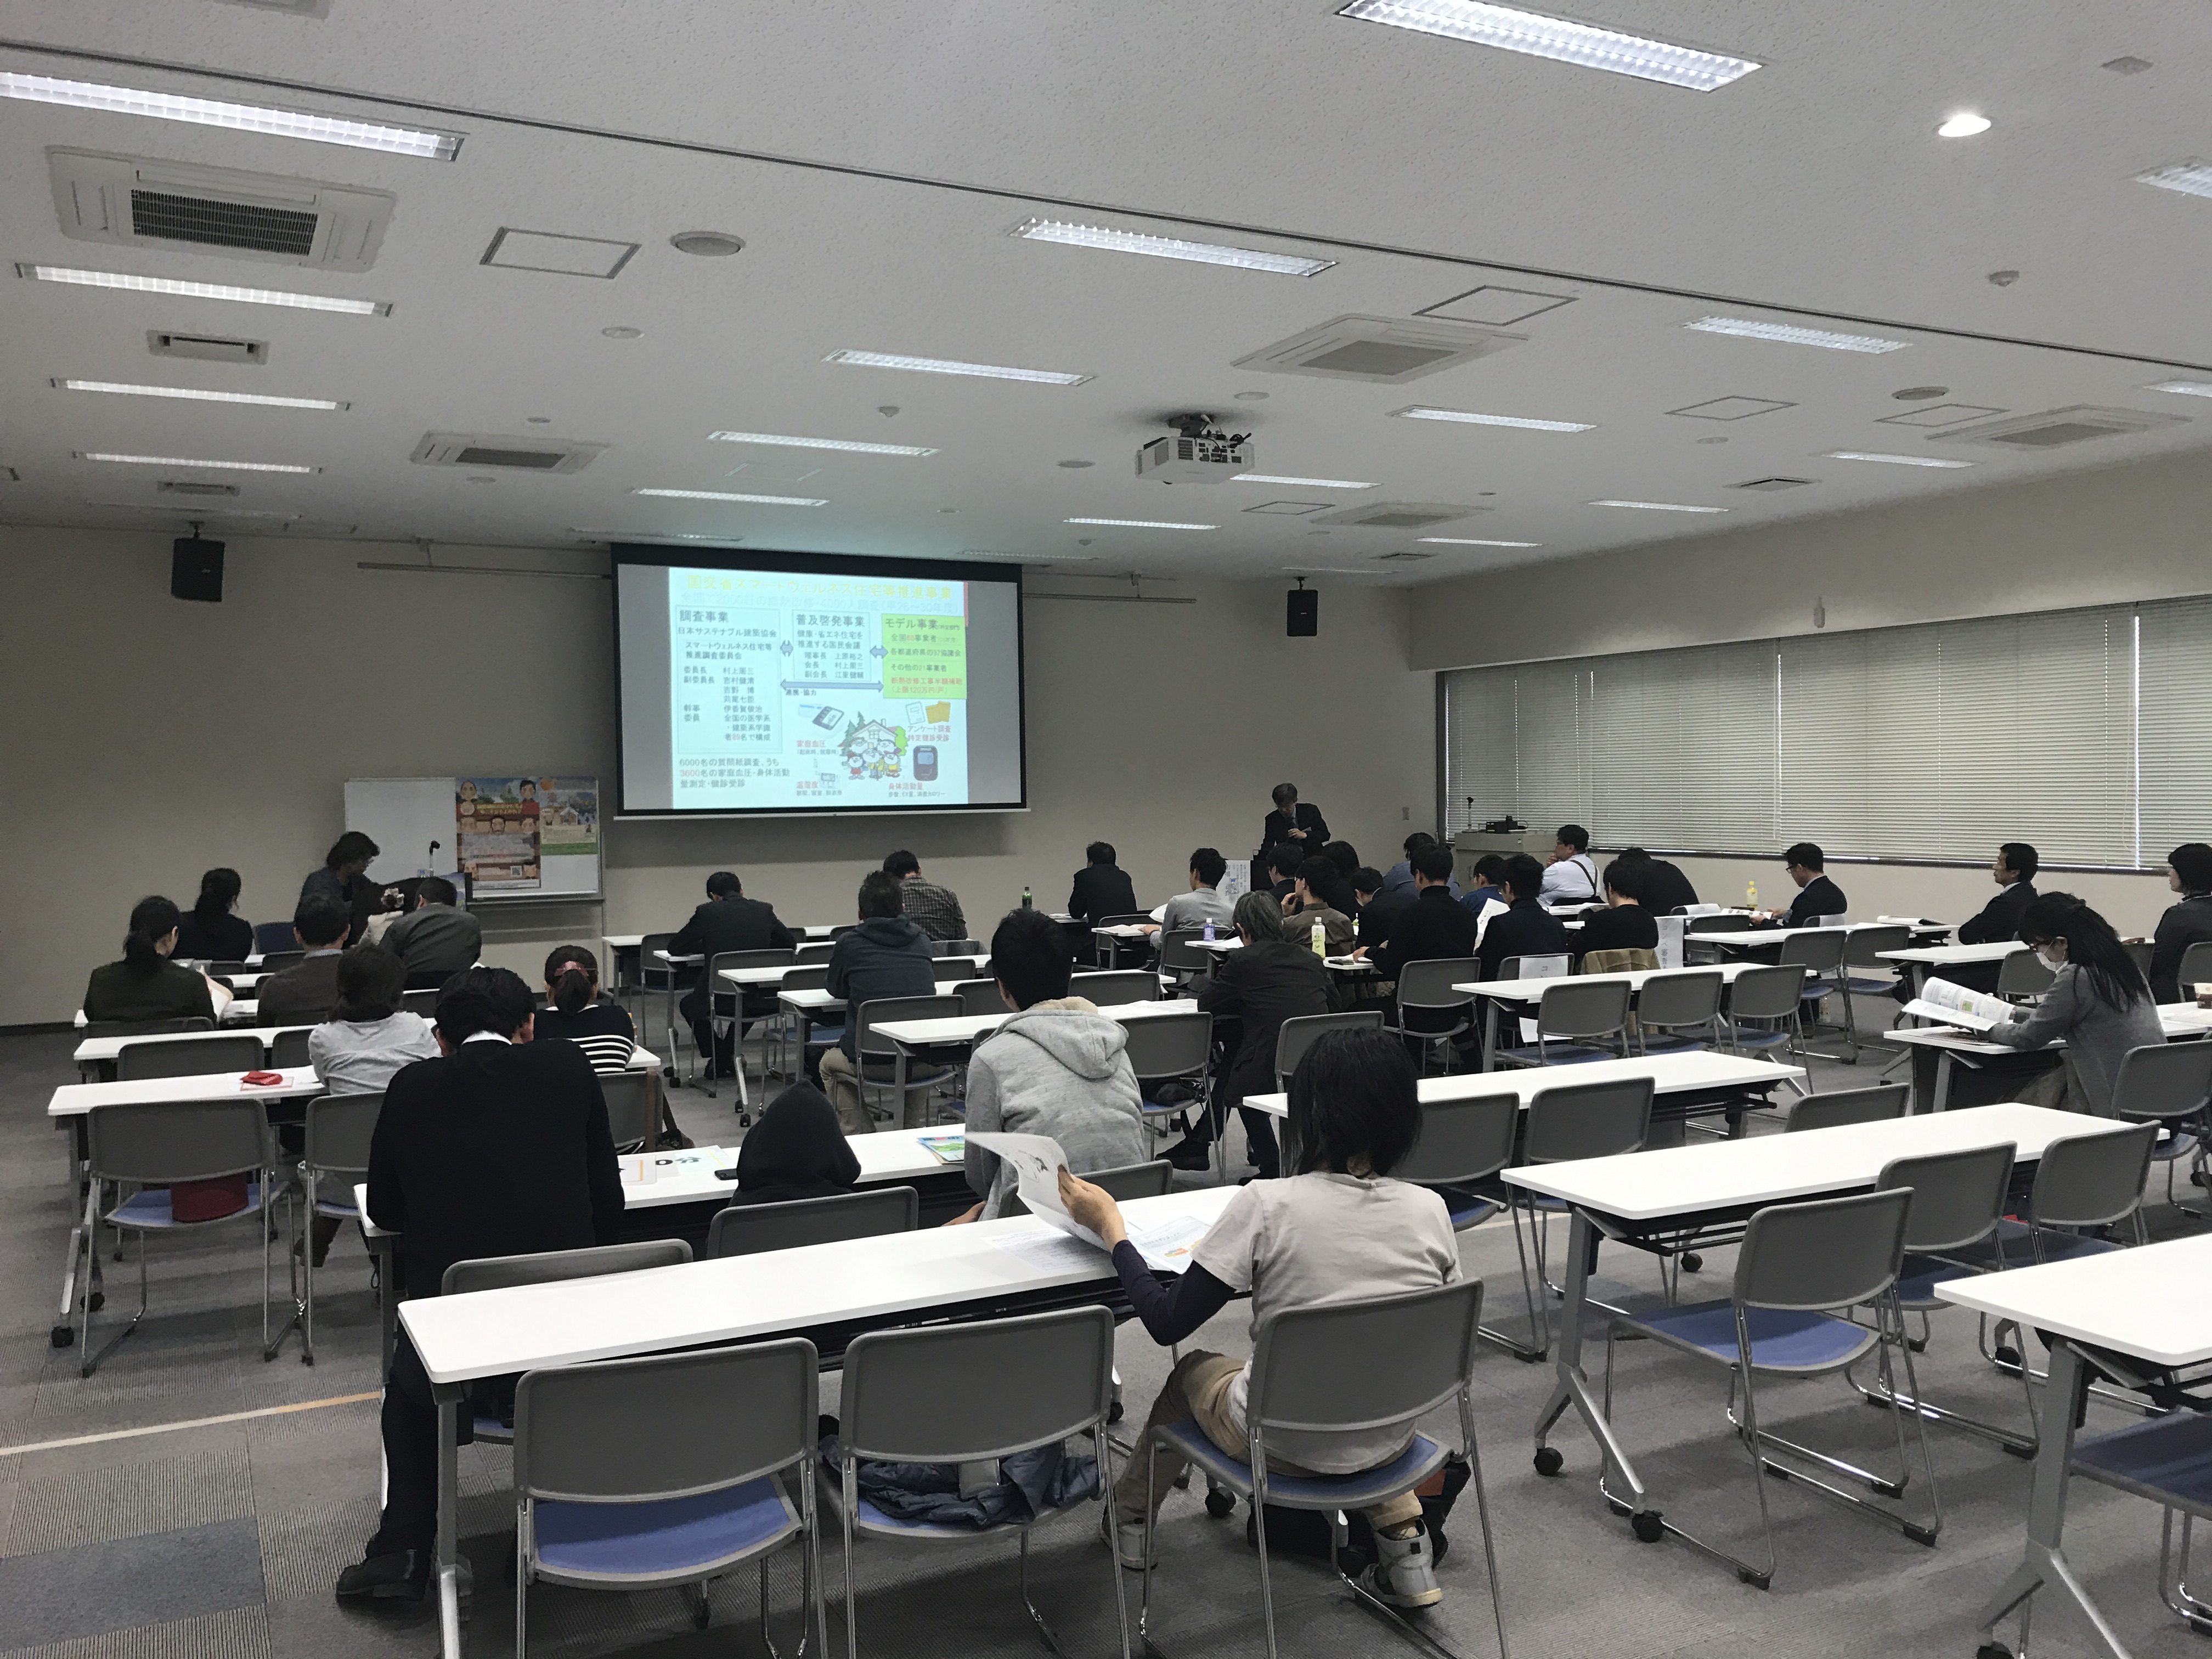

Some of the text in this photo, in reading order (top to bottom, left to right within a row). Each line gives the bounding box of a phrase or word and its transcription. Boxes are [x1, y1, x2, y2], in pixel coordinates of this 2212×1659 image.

[679, 610, 729, 623] 調査事業
[797, 613, 865, 627] 普及啓発事業
[678, 627, 777, 637] 日本サステナブル建築協会
[686, 641, 772, 651] スマートウェルネス住宅等
[798, 640, 861, 650] 推進する国民会議
[686, 651, 742, 660] 推進調査委員会
[805, 661, 819, 669] 会長
